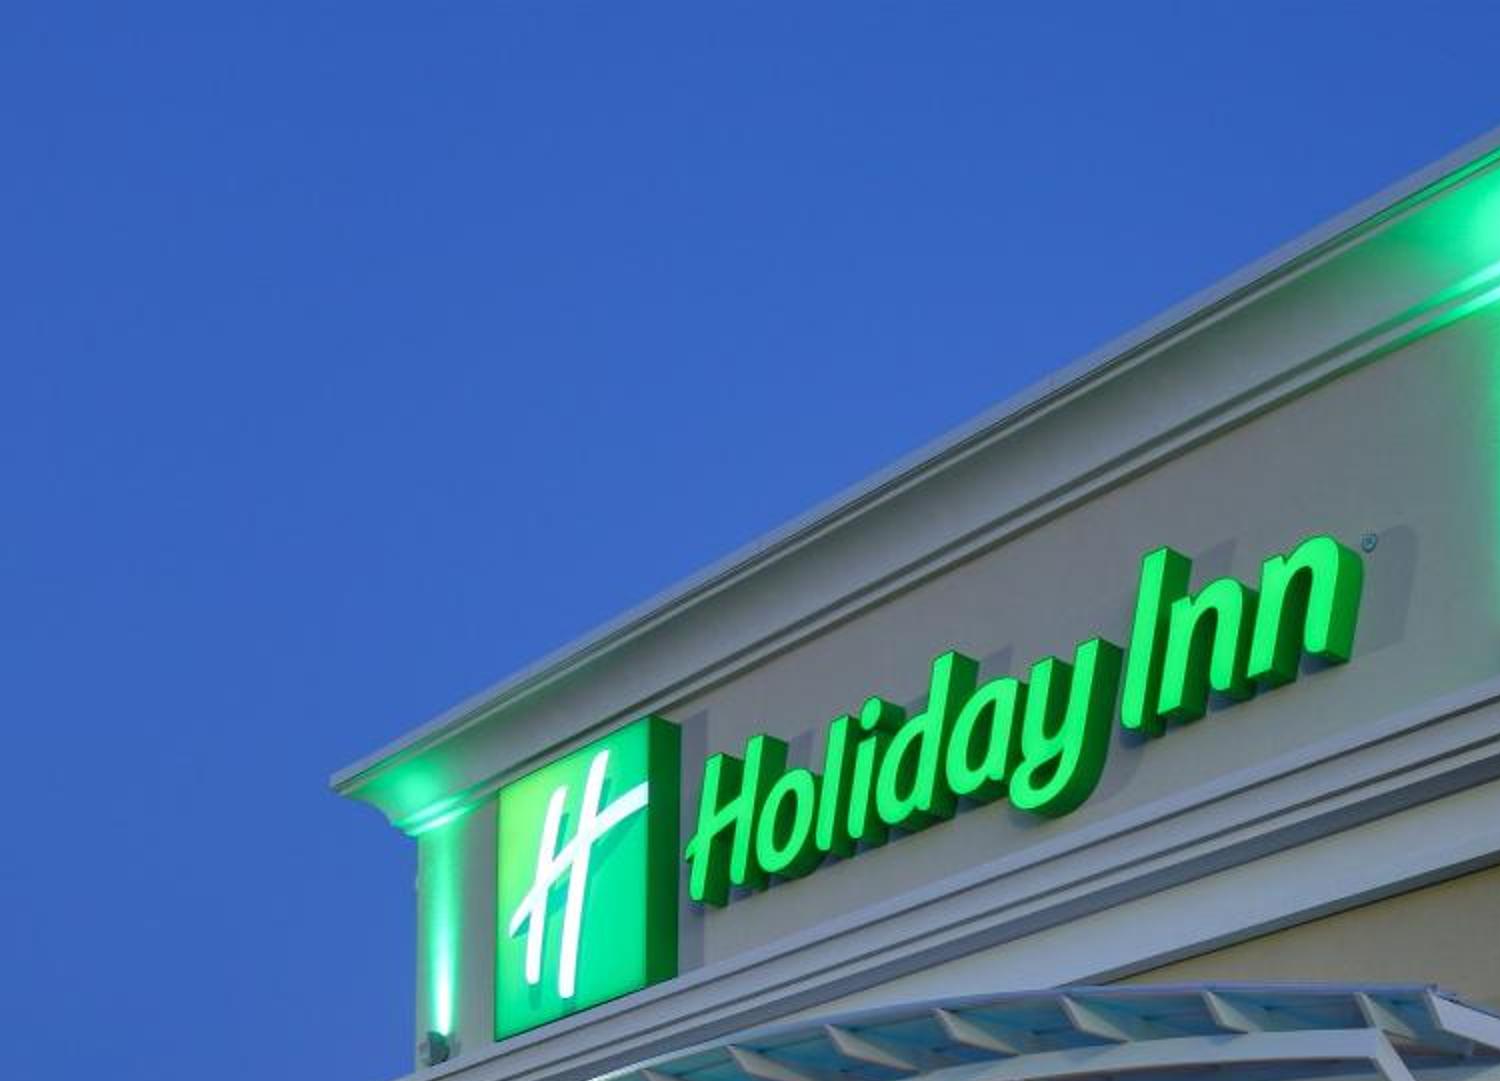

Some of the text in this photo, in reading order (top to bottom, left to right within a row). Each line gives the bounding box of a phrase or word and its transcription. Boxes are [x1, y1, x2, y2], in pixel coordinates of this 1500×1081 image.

[509, 749, 649, 999] H
[684, 534, 1352, 906] Holiday Inn
